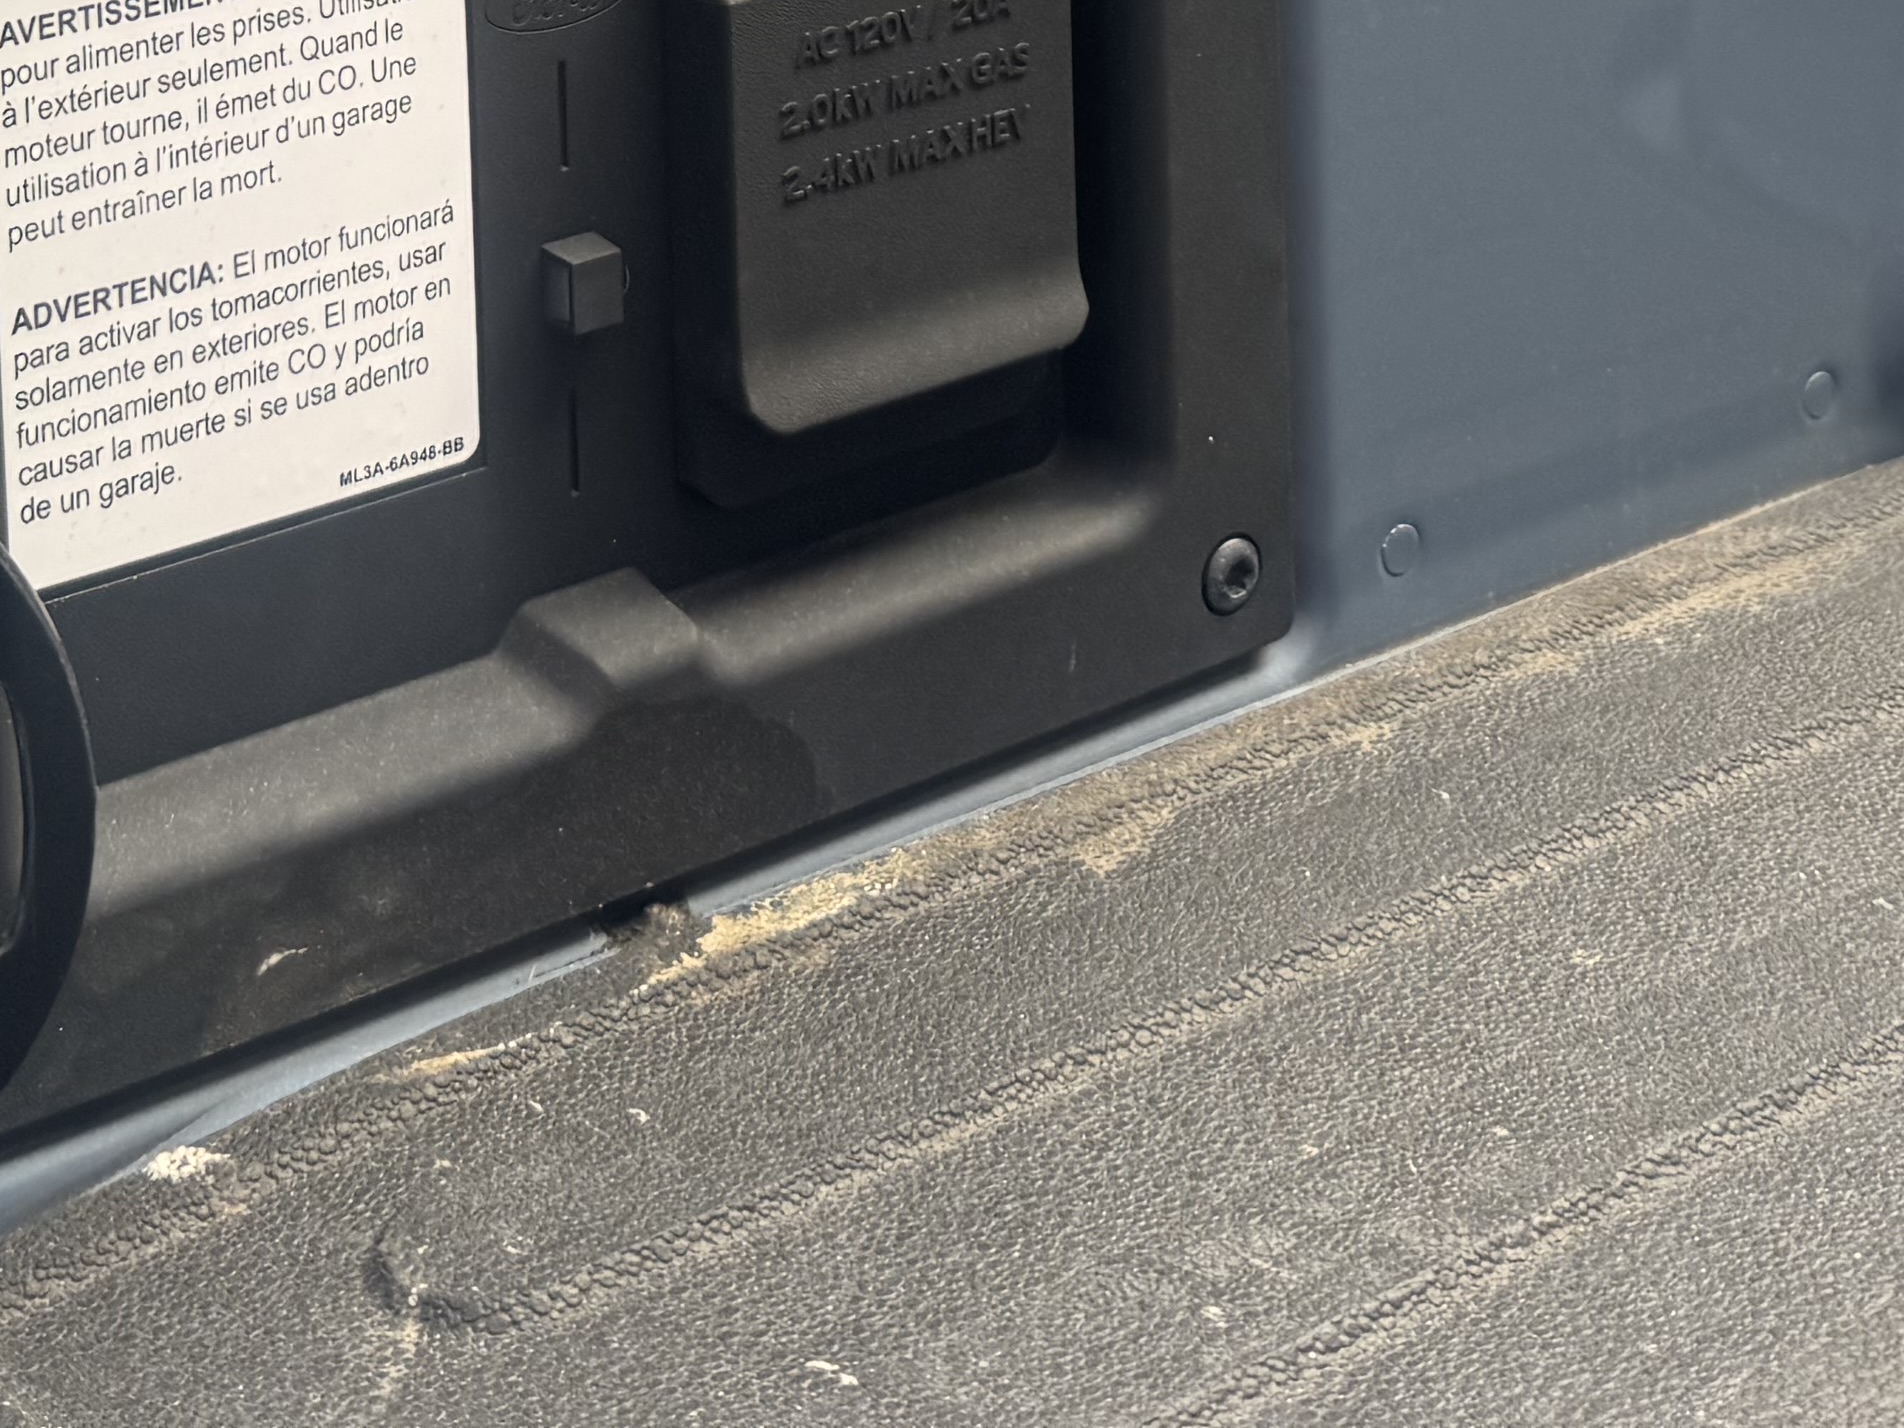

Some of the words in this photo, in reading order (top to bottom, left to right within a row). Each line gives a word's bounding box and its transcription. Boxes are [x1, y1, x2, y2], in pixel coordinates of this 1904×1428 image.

[0, 56, 61, 98] pour
[64, 29, 186, 76] alimenter
[189, 20, 227, 50] les
[231, 4, 313, 48] prises.
[0, 99, 19, 130] à
[23, 75, 153, 126] l'extérieur
[156, 41, 294, 96] seulement.
[298, 19, 379, 63] Quand
[383, 16, 405, 45] le
[794, 25, 841, 70] AC
[844, 4, 922, 57] 120V
[886, 56, 964, 111] MAX
[969, 41, 1032, 88] GAS
[3, 127, 98, 170] moteur
[100, 109, 191, 147] tourne,
[195, 94, 209, 126] il
[214, 82, 278, 121] émet
[281, 75, 312, 106] du
[317, 63, 365, 97] CO.
[369, 55, 418, 85] Une
[4, 160, 128, 209] utilisation
[132, 149, 150, 179] à
[155, 126, 272, 174] l'intérieur
[274, 114, 327, 145] d'un
[330, 93, 413, 138] garage
[887, 120, 966, 177] MAX
[965, 102, 1032, 154] HEV
[6, 208, 67, 255] peut
[70, 184, 189, 232] entraîner
[191, 175, 214, 204] la
[219, 158, 283, 198] mort.
[9, 259, 225, 338] ADVERTENCIA:
[232, 248, 257, 281] El
[263, 235, 333, 273] motor
[336, 197, 455, 254] funcionará
[12, 340, 71, 382] para
[77, 315, 163, 358] activar
[167, 305, 204, 335] los
[209, 258, 391, 323] tomacorrientes,
[397, 240, 448, 273] usar
[13, 356, 147, 412] solamente
[152, 348, 185, 376] en
[190, 315, 317, 366] exteriores.
[323, 297, 347, 331] El
[353, 284, 420, 324] motor
[423, 276, 452, 302] en
[14, 378, 208, 451] funcionamiento
[213, 358, 281, 397] emite
[286, 342, 328, 376] CO
[333, 340, 348, 372] y
[353, 315, 425, 366] podría
[17, 444, 106, 488] causar
[110, 434, 133, 463] la
[140, 410, 227, 456] muerte
[232, 396, 253, 429] si
[258, 395, 289, 422] se
[294, 381, 338, 411] usa
[343, 355, 431, 398] adentro
[338, 435, 466, 489] ML3A-6A948-BB
[18, 494, 53, 526] de
[59, 487, 91, 515] un
[97, 460, 183, 511] garaje.
